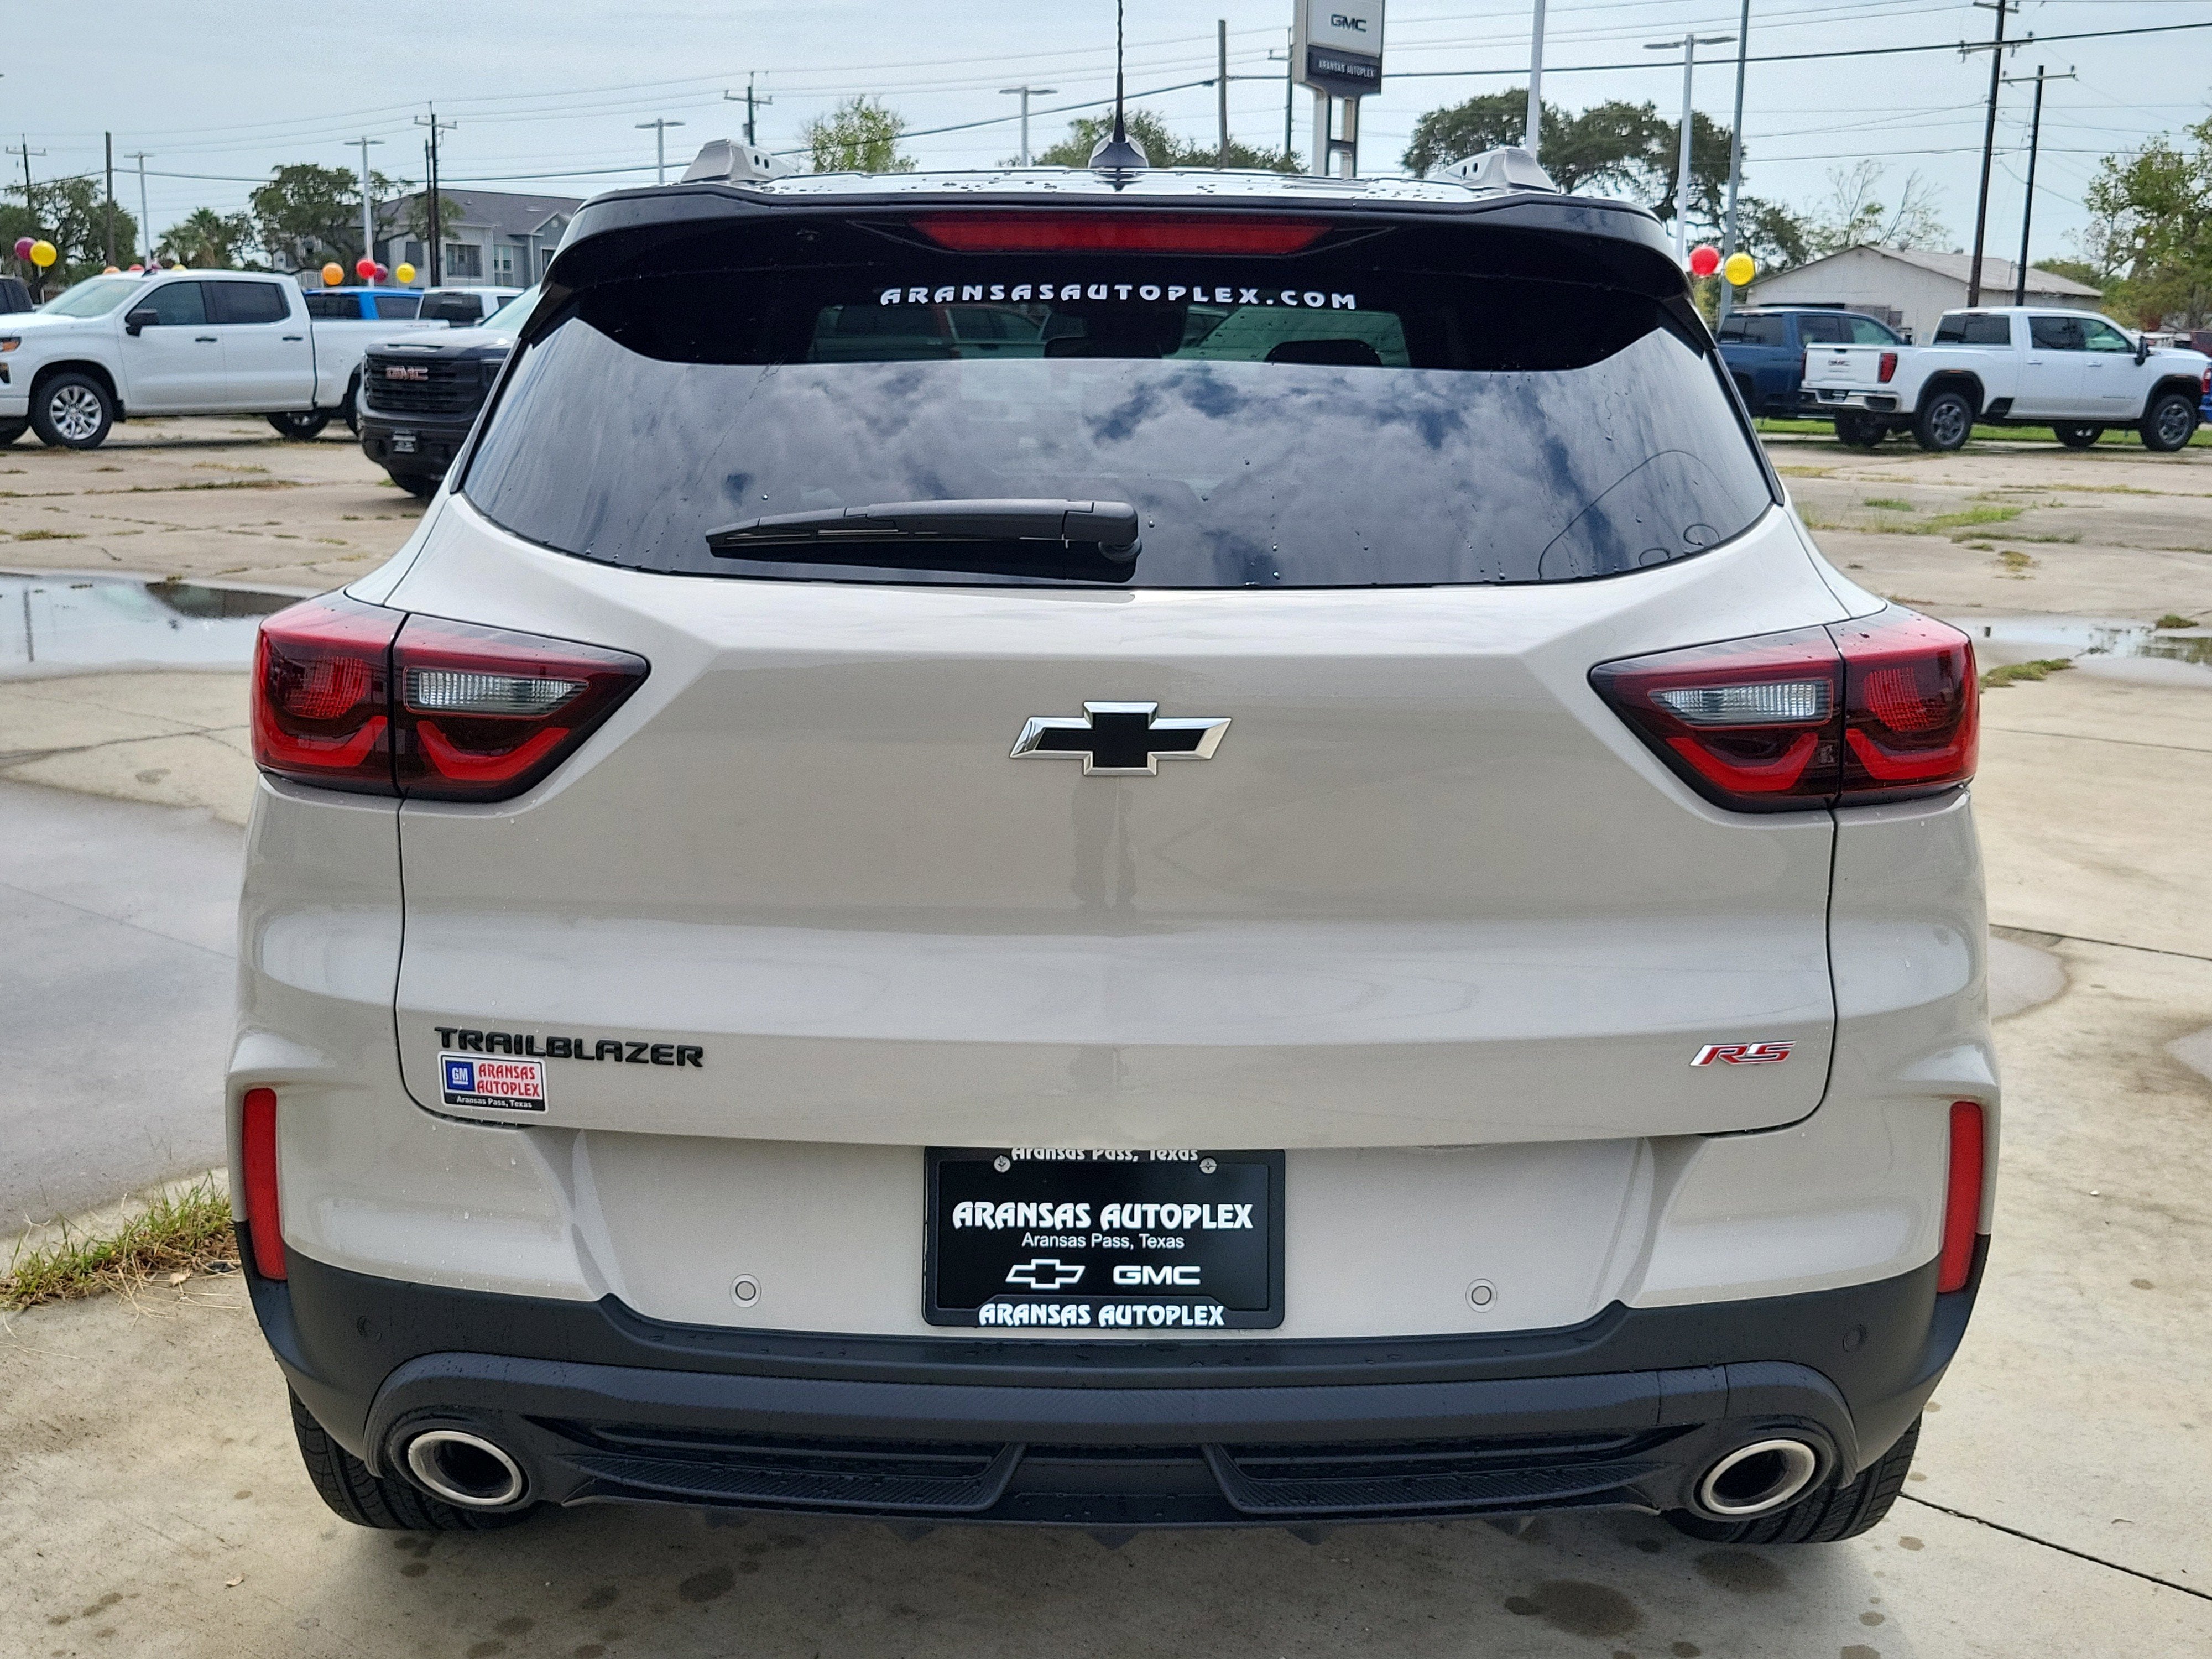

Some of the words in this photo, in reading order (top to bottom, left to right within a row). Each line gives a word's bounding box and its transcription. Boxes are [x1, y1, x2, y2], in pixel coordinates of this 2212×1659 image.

[1331, 14, 1366, 32] GMC
[880, 285, 1357, 310] ARANSASAUTOPLEX.COM
[385, 365, 429, 381] GMC
[434, 1027, 704, 1068] TRAILBLAZER
[1689, 1040, 1796, 1067] RS
[452, 1067, 469, 1081] GM
[478, 1063, 535, 1080] ARANSAS
[477, 1079, 540, 1097] AUTOPLEX
[457, 1095, 487, 1105] Aransas
[488, 1098, 508, 1108] Pass,
[510, 1099, 533, 1108] Texas
[952, 1202, 1091, 1230] ARANSAS
[1099, 1203, 1253, 1230] AUTOPLEX
[1021, 1232, 1086, 1248] Aransas
[1091, 1233, 1134, 1250] Pass,
[1139, 1234, 1185, 1249] Texas
[1113, 1265, 1201, 1285] GMC
[978, 1303, 1091, 1326] ARANSAS
[1098, 1305, 1224, 1327] AUTOPLEX
